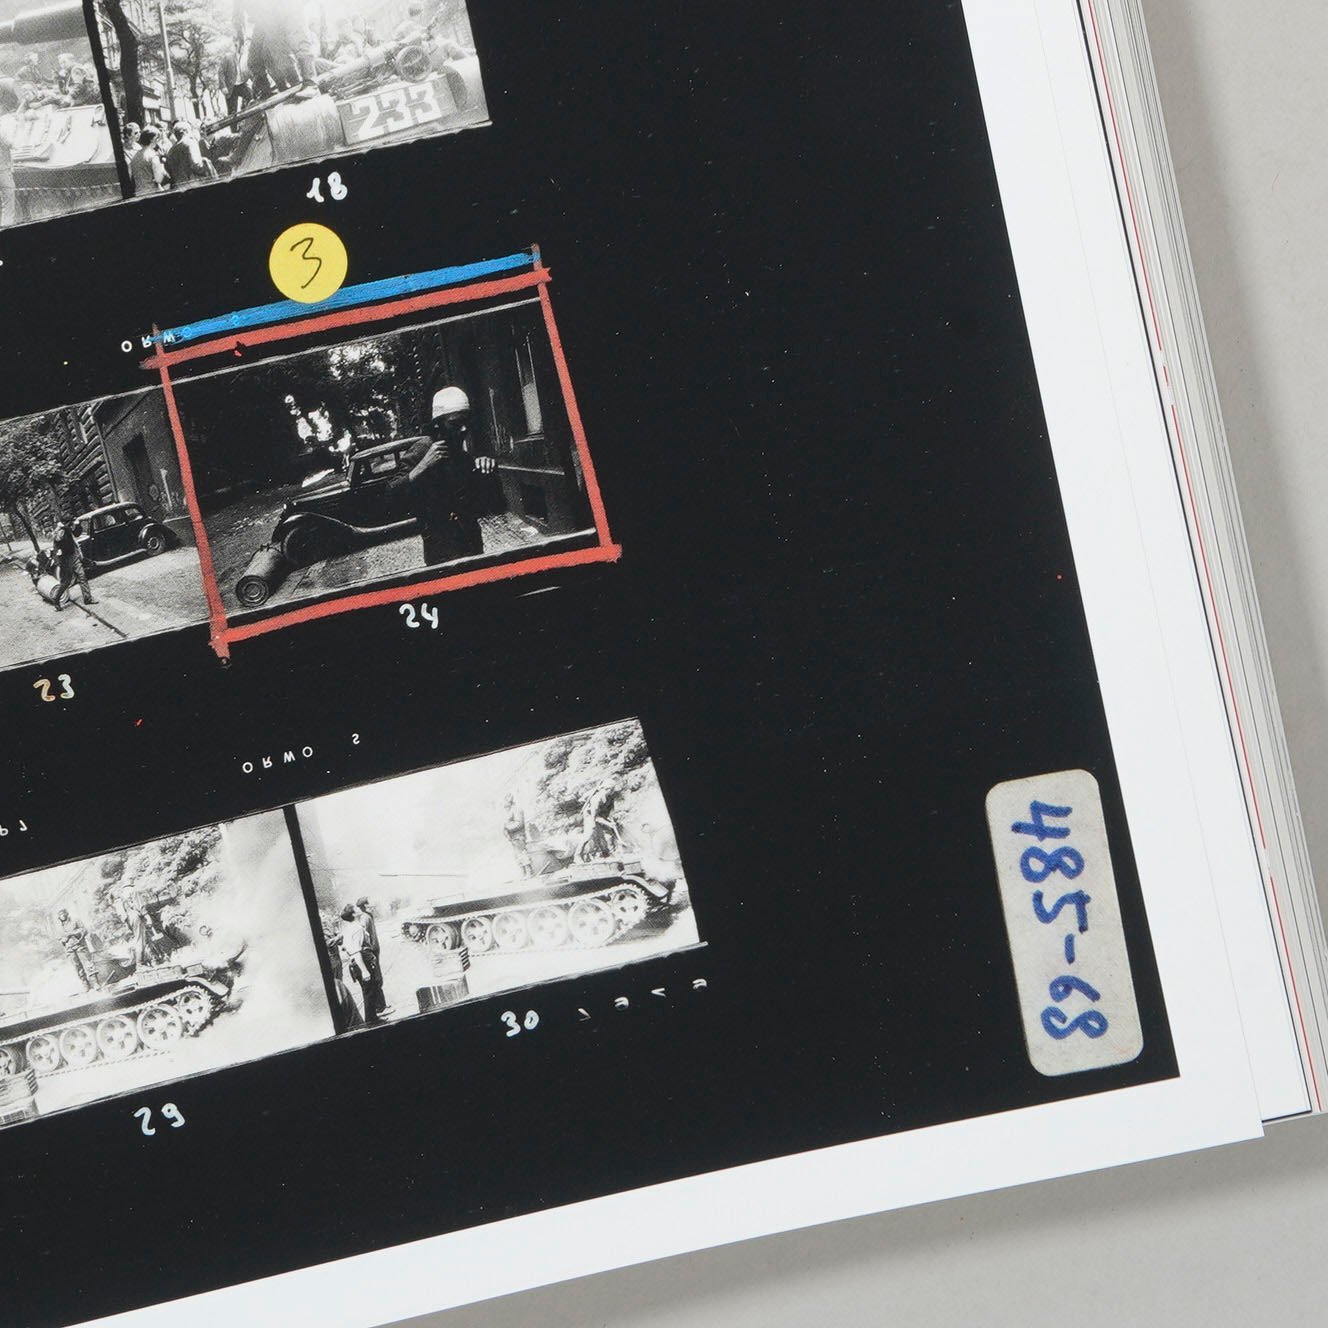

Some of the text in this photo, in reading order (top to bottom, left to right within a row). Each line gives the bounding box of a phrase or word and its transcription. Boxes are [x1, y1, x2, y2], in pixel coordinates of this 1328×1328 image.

[351, 82, 442, 141] 233
[307, 172, 348, 203] 18
[289, 236, 323, 290] 3
[398, 602, 440, 629] 24
[33, 674, 75, 702] 23
[1011, 799, 1110, 1041] 485-68
[500, 1009, 540, 1038] 30
[133, 1102, 186, 1136] 29
